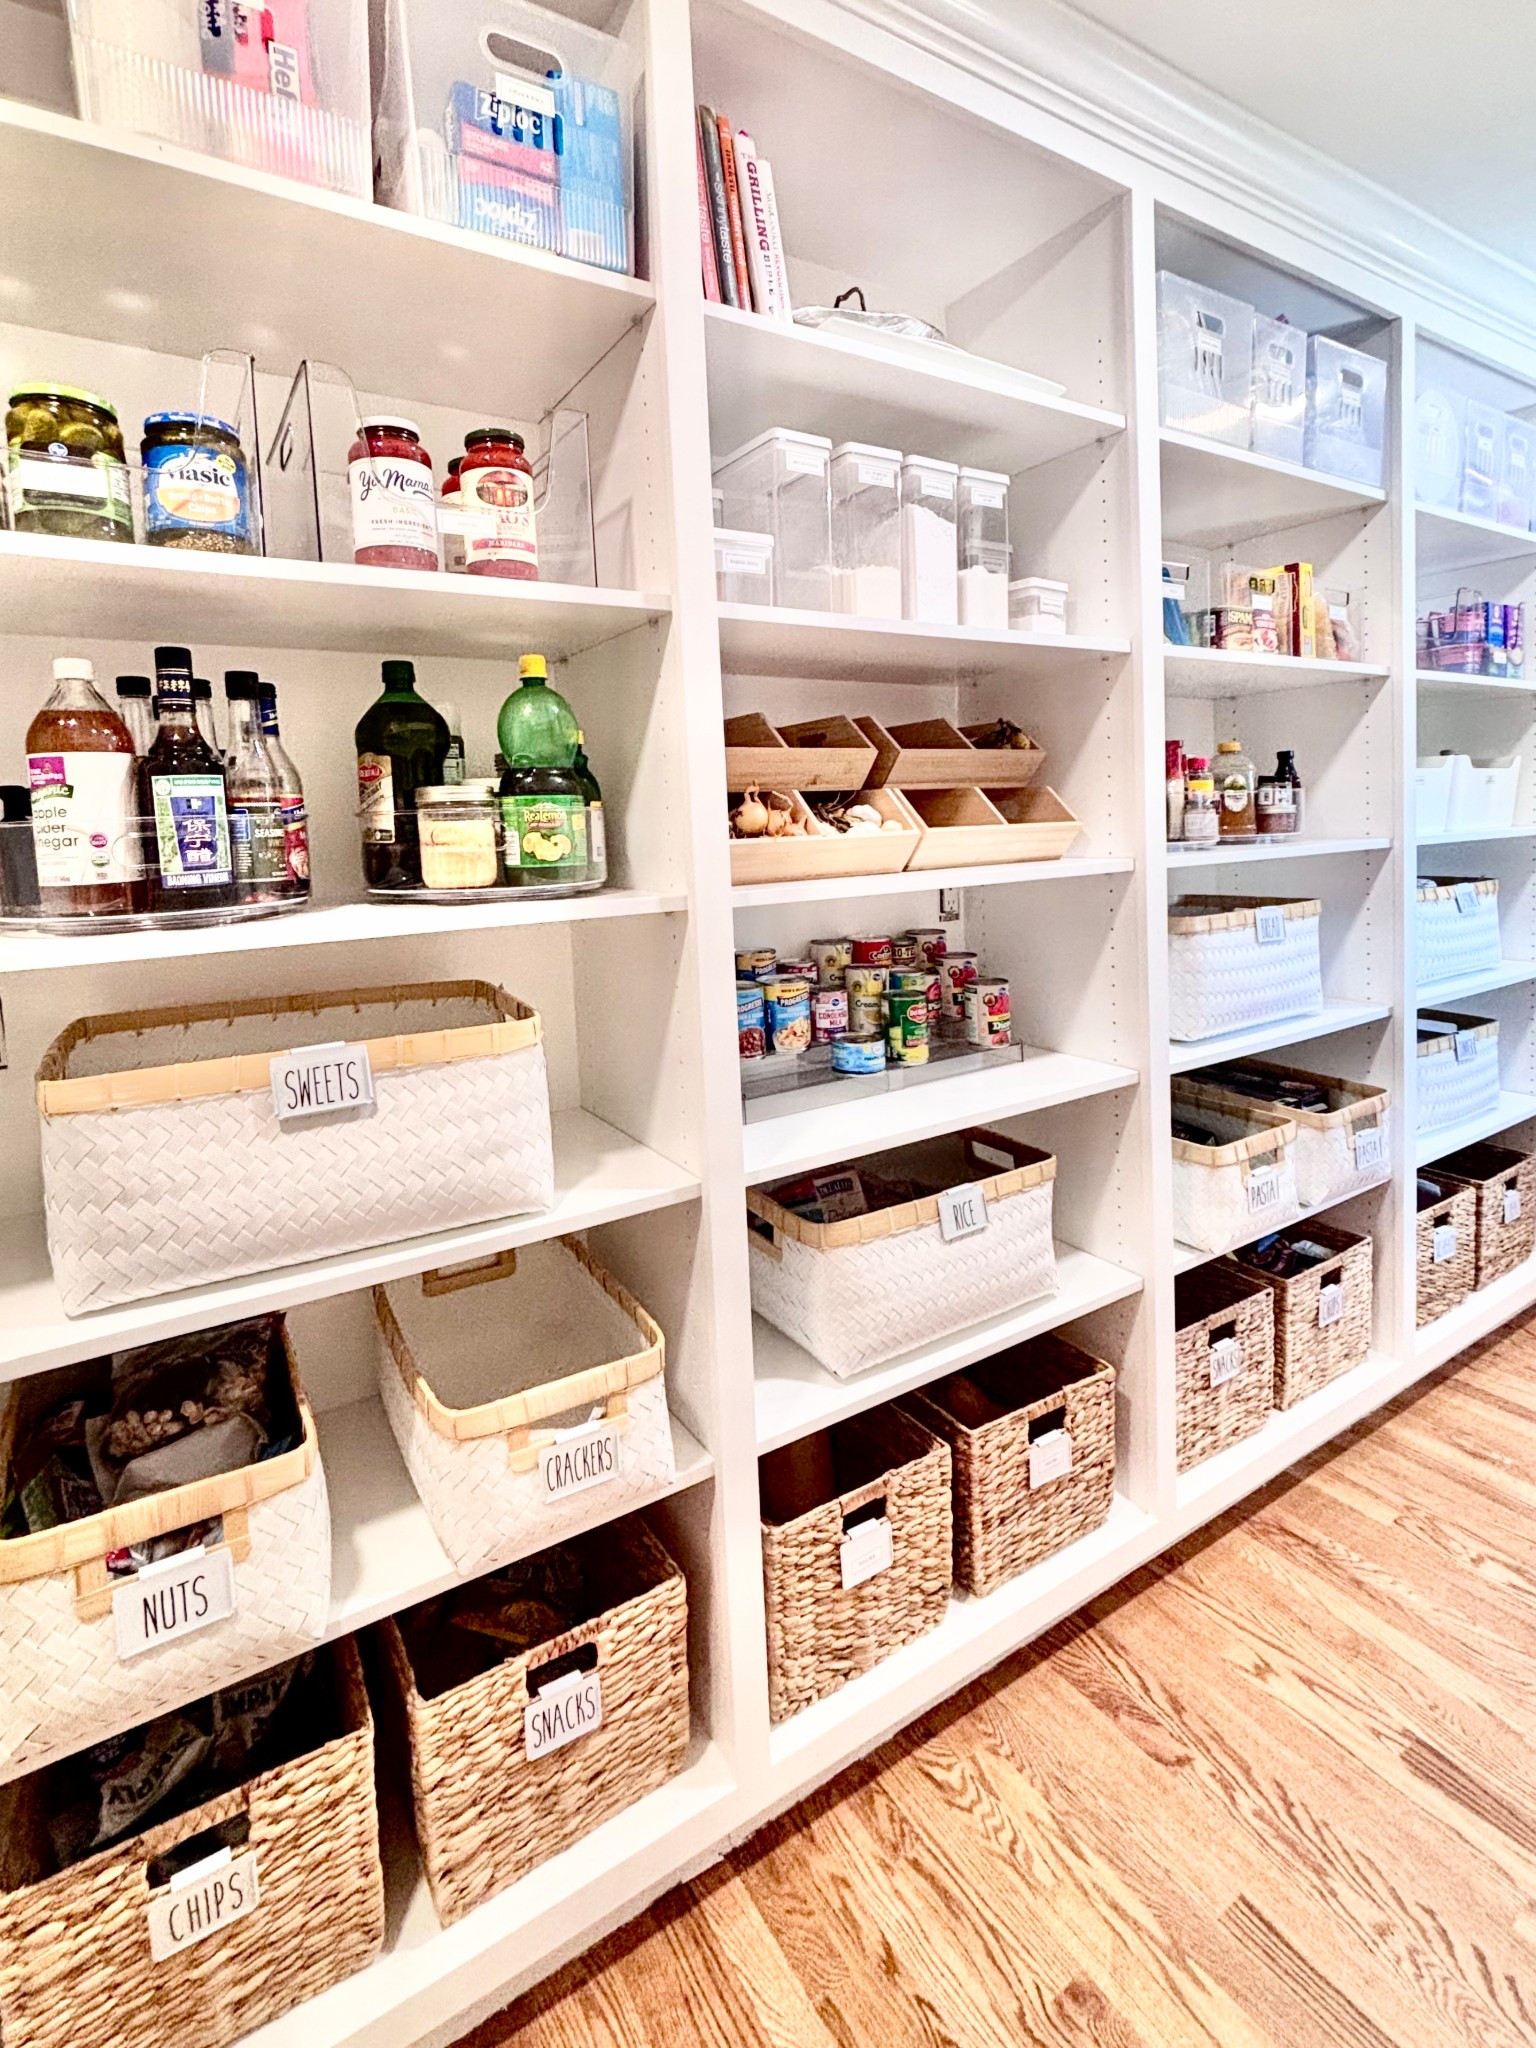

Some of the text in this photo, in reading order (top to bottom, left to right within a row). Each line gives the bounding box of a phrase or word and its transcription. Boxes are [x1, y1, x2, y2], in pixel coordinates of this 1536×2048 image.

[713, 180, 732, 263] skinnytaste
[746, 161, 770, 251] GRILLING
[1229, 610, 1253, 625] SPAM
[38, 836, 79, 851] negar
[285, 1061, 359, 1110] SWEETS
[952, 1199, 977, 1231] RICE
[1250, 1179, 1276, 1209] PASTA
[546, 1436, 613, 1492] CRACKERS
[142, 1574, 209, 1639] NUTS
[531, 1686, 596, 1749] SNACKS
[168, 1871, 244, 1942] CHIPS
